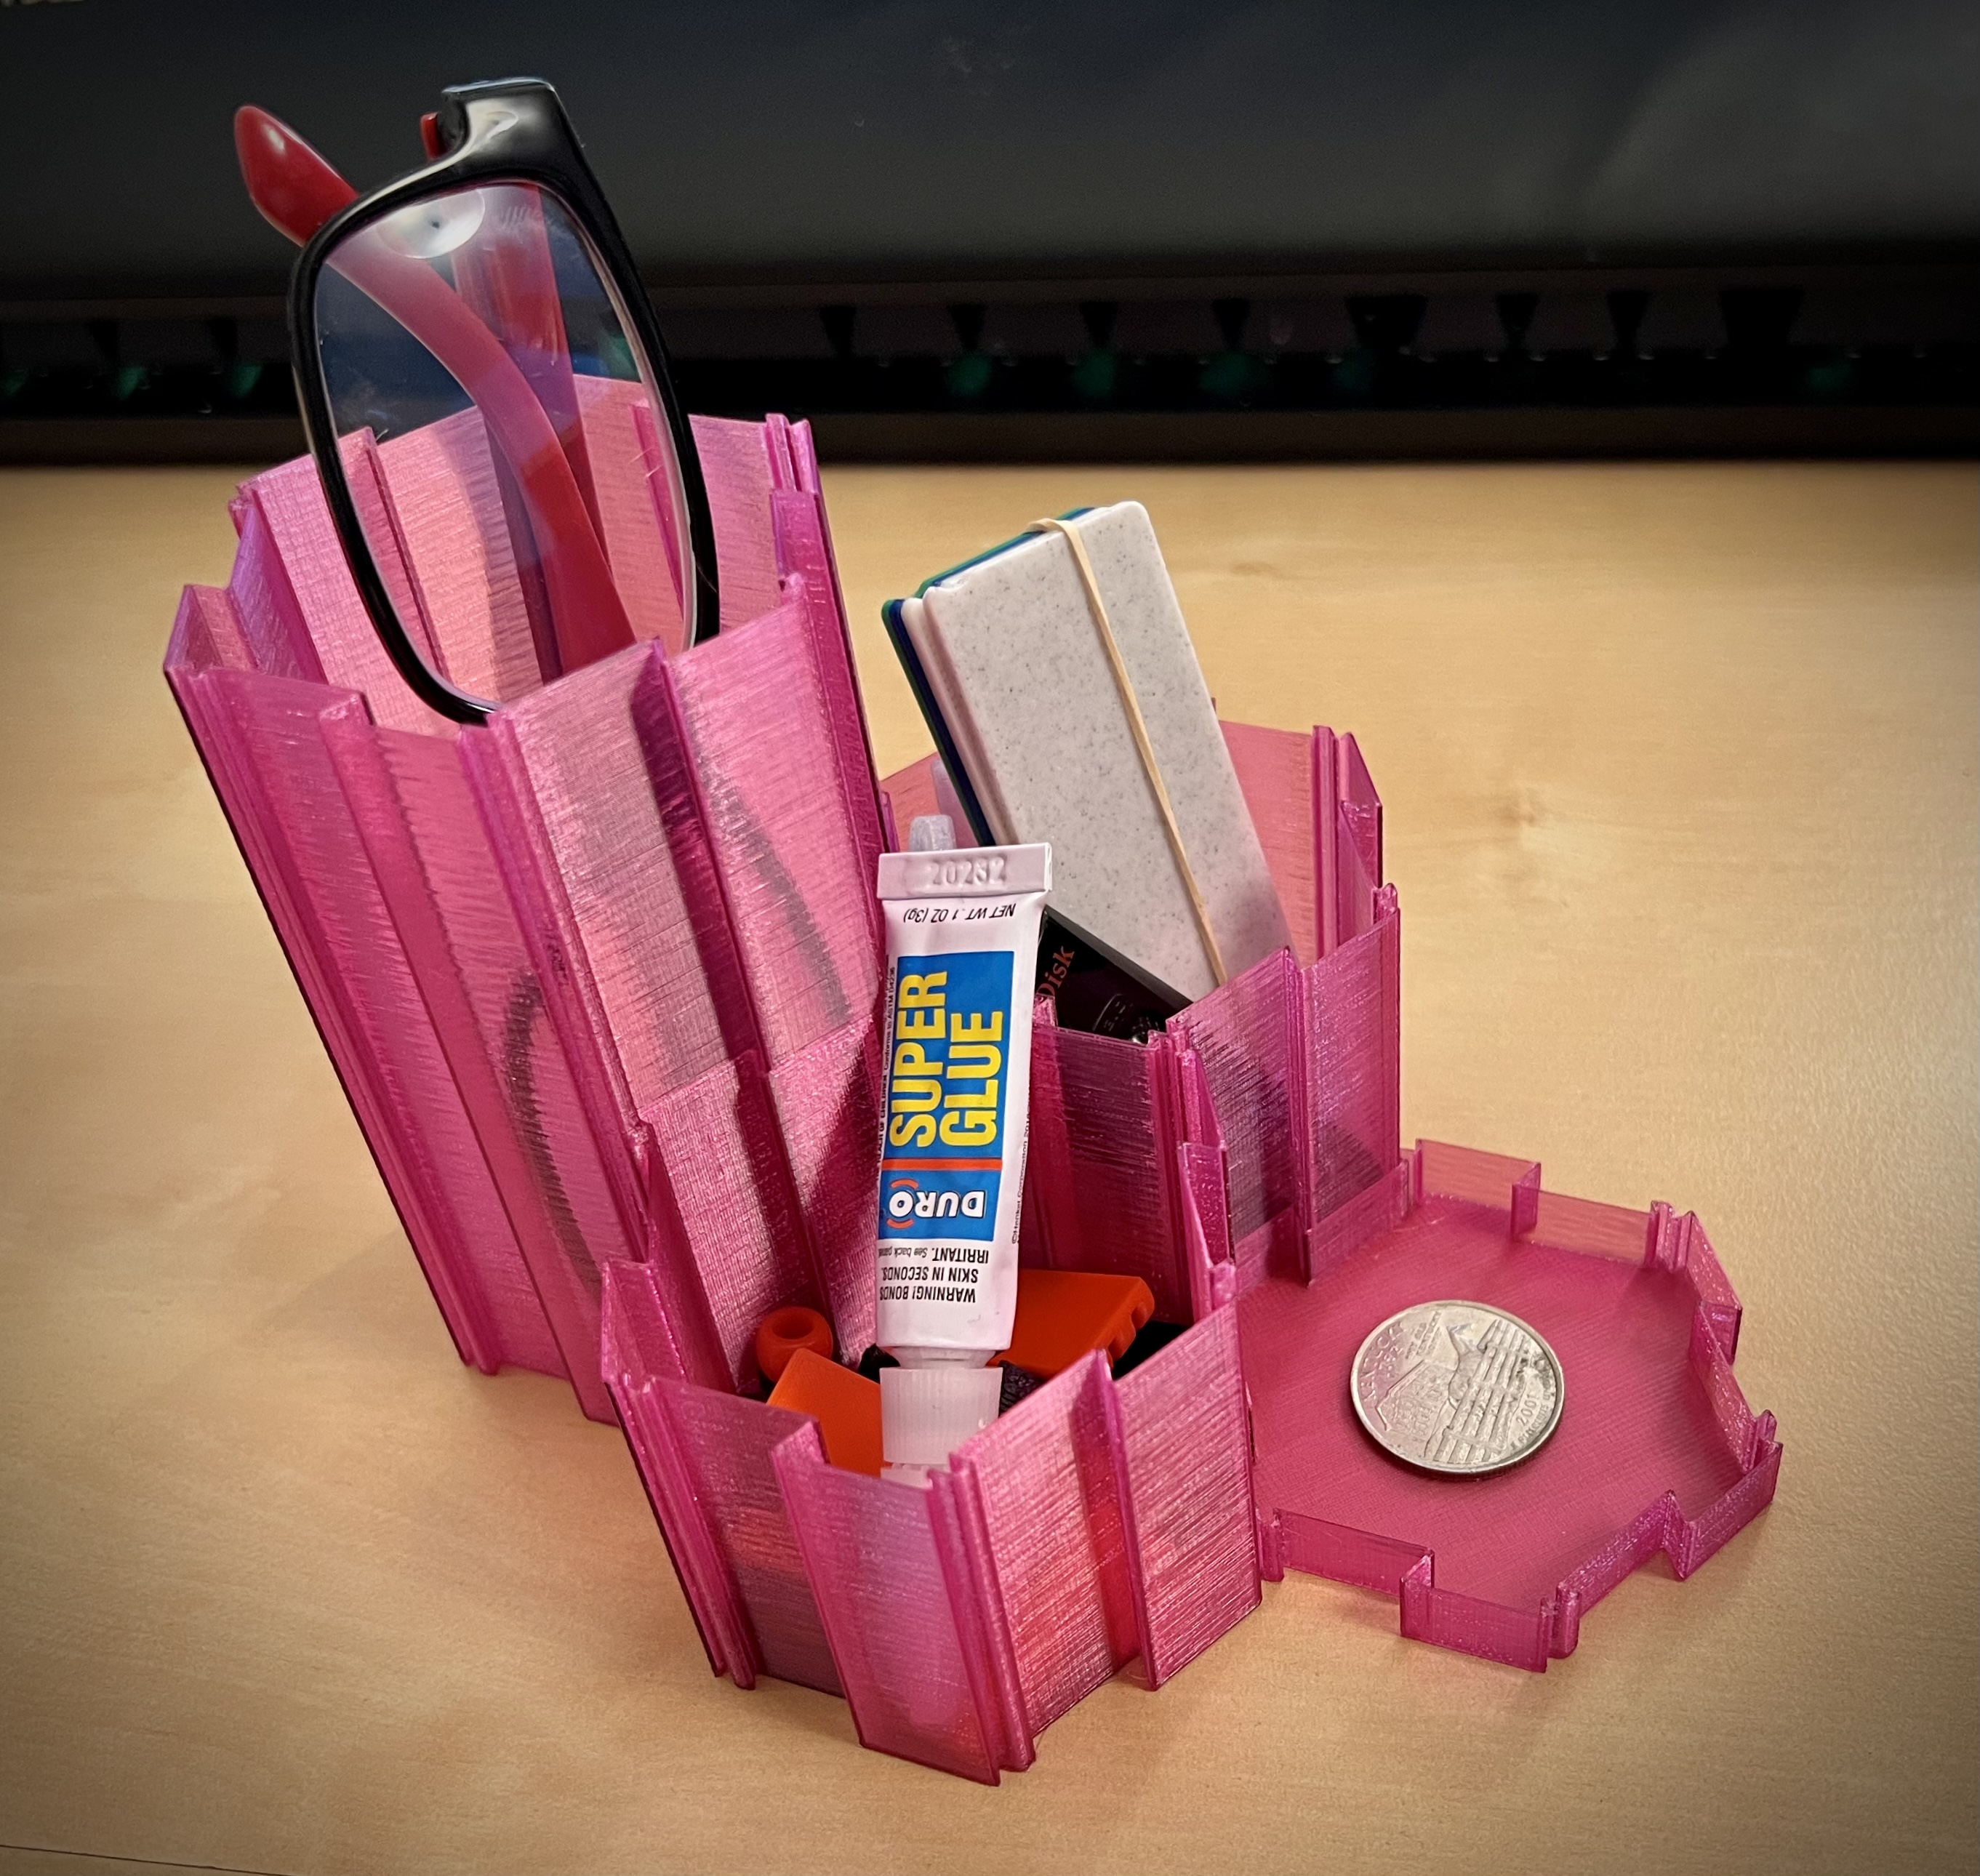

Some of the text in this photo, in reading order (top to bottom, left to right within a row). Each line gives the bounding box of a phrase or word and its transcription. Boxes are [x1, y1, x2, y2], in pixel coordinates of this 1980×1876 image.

[903, 907, 929, 923] (3g)
[930, 908, 949, 923] OZ
[965, 907, 987, 921] WT
[988, 903, 1017, 918] NET
[886, 1021, 892, 1030] to
[883, 1031, 892, 1070] Conforms
[889, 971, 947, 1147] SUPER
[939, 1011, 1003, 1147] GLUE
[1017, 1141, 1028, 1197] Corporation
[889, 1190, 987, 1219] DURO
[894, 1247, 912, 1258] back
[914, 1247, 928, 1258] See
[932, 1248, 989, 1264] IRRITANT.
[881, 1266, 979, 1283] SKIN IN SECONDS.
[880, 1286, 976, 1303] WARNING! BONDS
[1515, 1393, 1539, 1426] 2001
